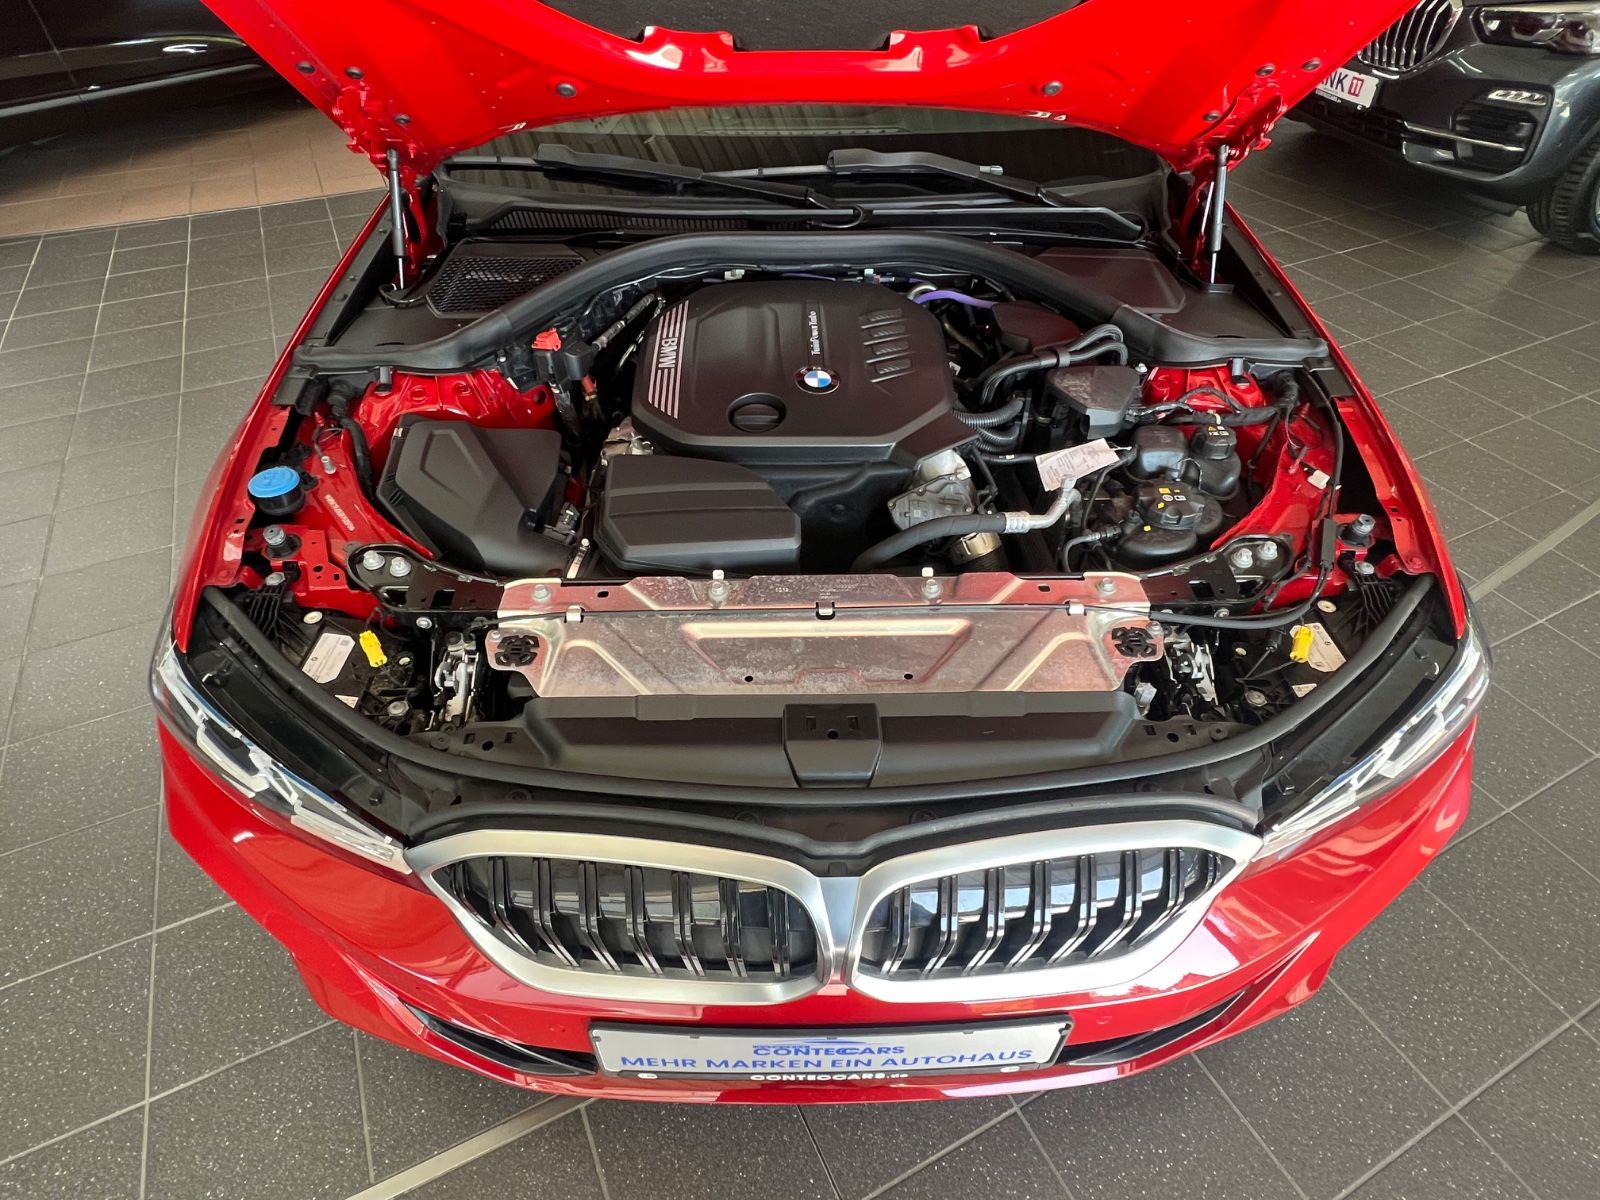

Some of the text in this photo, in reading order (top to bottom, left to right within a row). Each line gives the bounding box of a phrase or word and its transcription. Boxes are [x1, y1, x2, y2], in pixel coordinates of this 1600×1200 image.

[1321, 70, 1348, 92] NK
[658, 337, 678, 368] BMW
[621, 1050, 1032, 1069] MEHR MARKEN EIN AUTOHAUS
[752, 1047, 905, 1056] CONTECCARS
